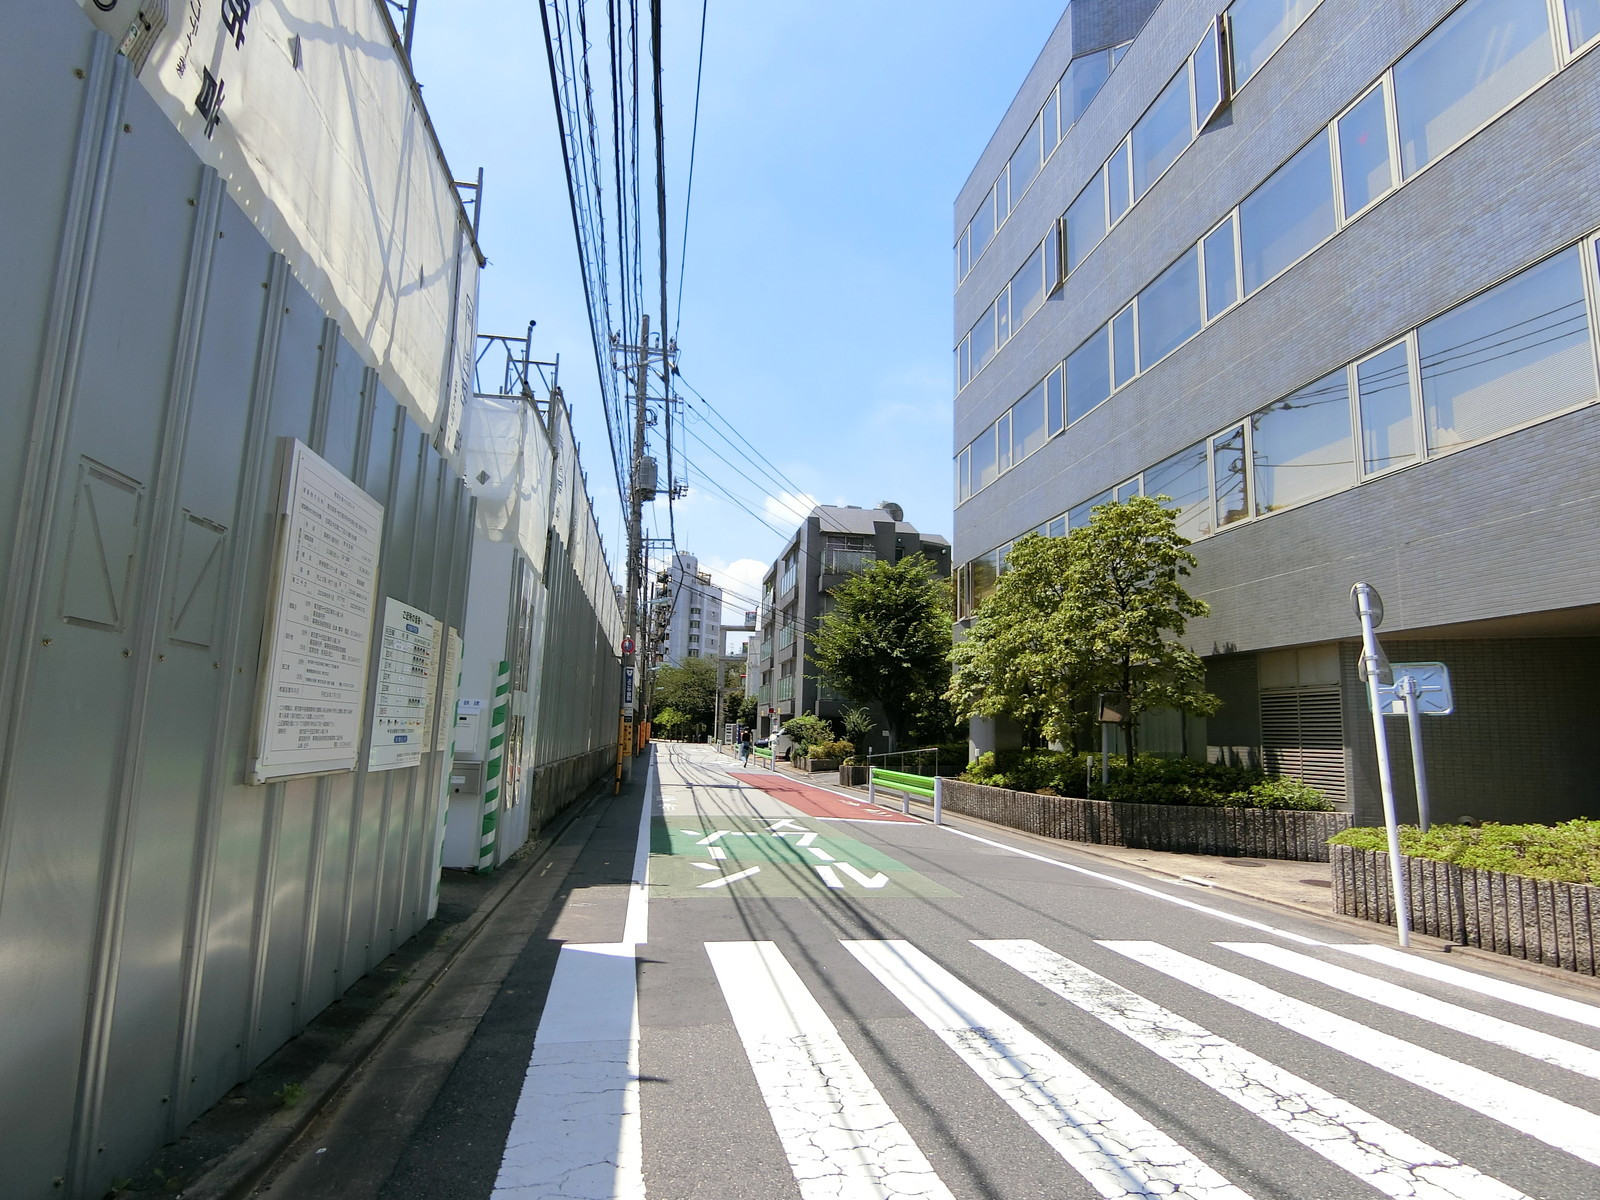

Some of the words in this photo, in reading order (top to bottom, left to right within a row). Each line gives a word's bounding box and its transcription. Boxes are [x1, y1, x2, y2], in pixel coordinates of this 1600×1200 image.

[680, 829, 761, 889] ゾーン
[752, 818, 890, 889] スクール
